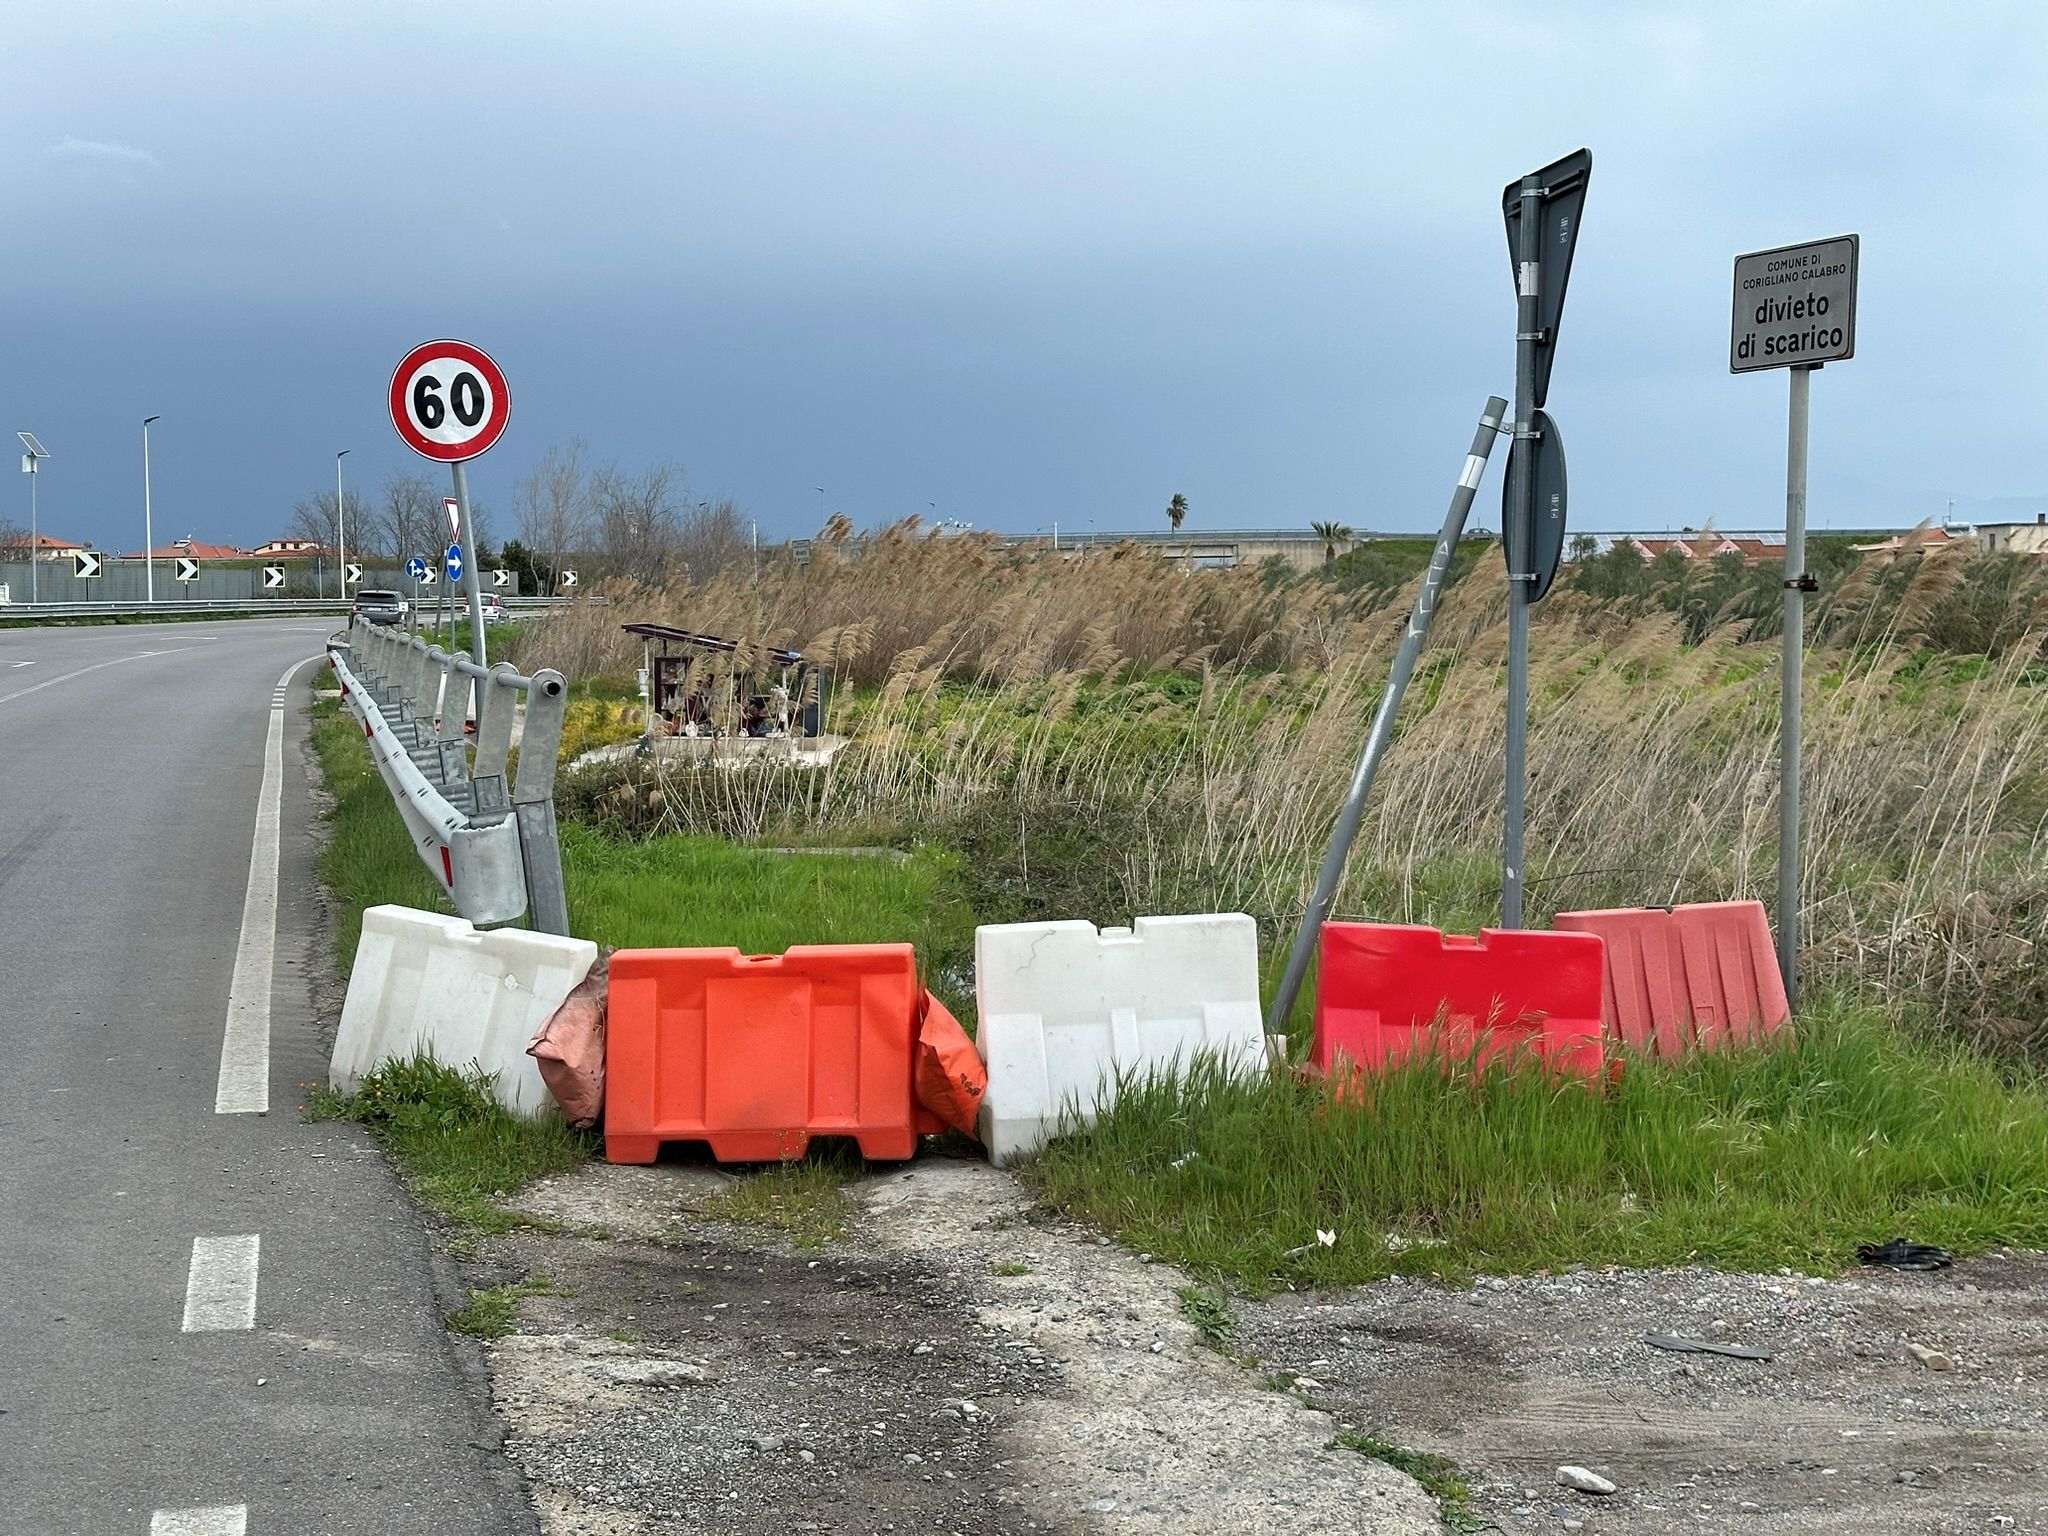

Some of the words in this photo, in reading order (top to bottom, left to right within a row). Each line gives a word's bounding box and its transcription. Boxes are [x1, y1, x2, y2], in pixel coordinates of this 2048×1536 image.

[1743, 272, 1799, 290] CORIGLIANO
[1801, 263, 1846, 281] CALABRO
[1767, 256, 1808, 272] COMUNE
[1811, 254, 1821, 265] DI
[1755, 292, 1829, 324] divieto
[1737, 333, 1756, 359] di
[1764, 325, 1843, 355] scarico
[413, 371, 485, 429] 60
